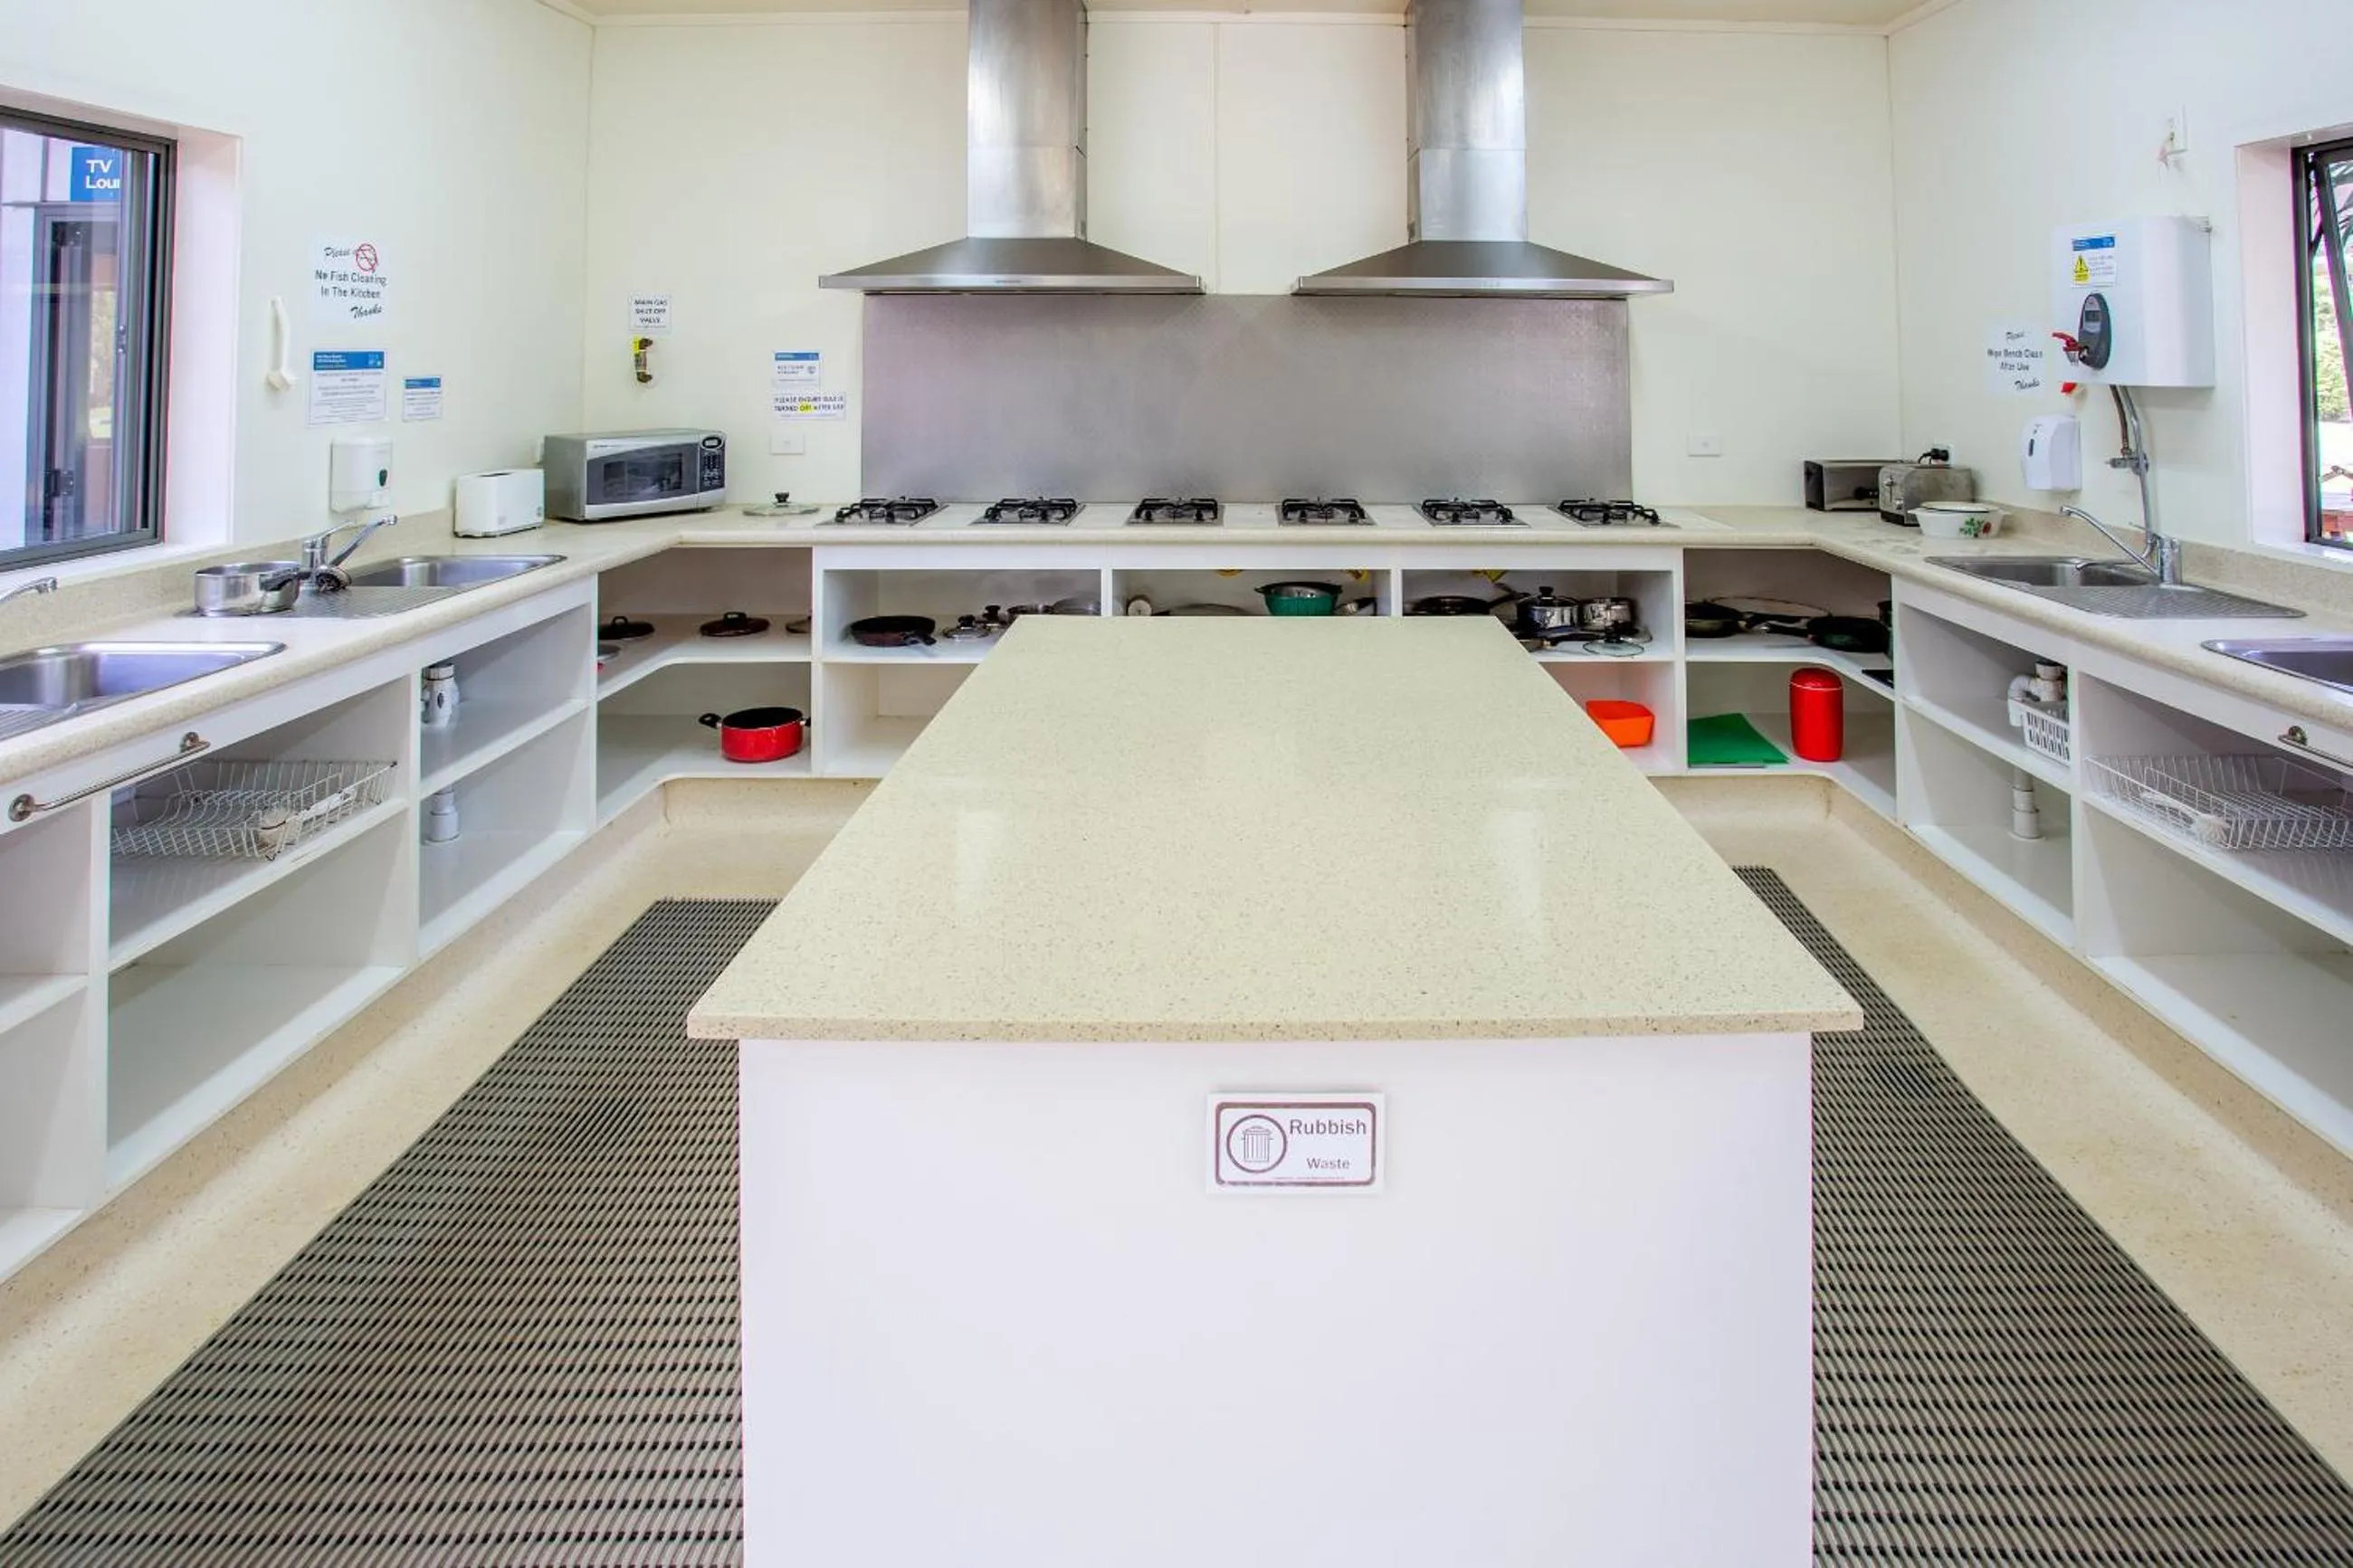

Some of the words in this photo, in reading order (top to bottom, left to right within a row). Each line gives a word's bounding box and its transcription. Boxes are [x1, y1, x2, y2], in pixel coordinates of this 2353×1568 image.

[86, 159, 113, 174] TV
[314, 270, 328, 280] No
[330, 271, 348, 281] Fish
[351, 272, 387, 287] Cleaning
[320, 286, 329, 297] In
[332, 286, 348, 298] The
[350, 288, 381, 299] Kitchen
[350, 304, 382, 318] Thanks
[2004, 348, 2023, 358] Bench
[2024, 348, 2043, 358] Clean
[2000, 361, 2015, 370] After
[2016, 362, 2029, 371] Use
[2015, 377, 2040, 389] Thanks
[1290, 1119, 1367, 1136] Rubbish
[1306, 1157, 1350, 1170] Waste
